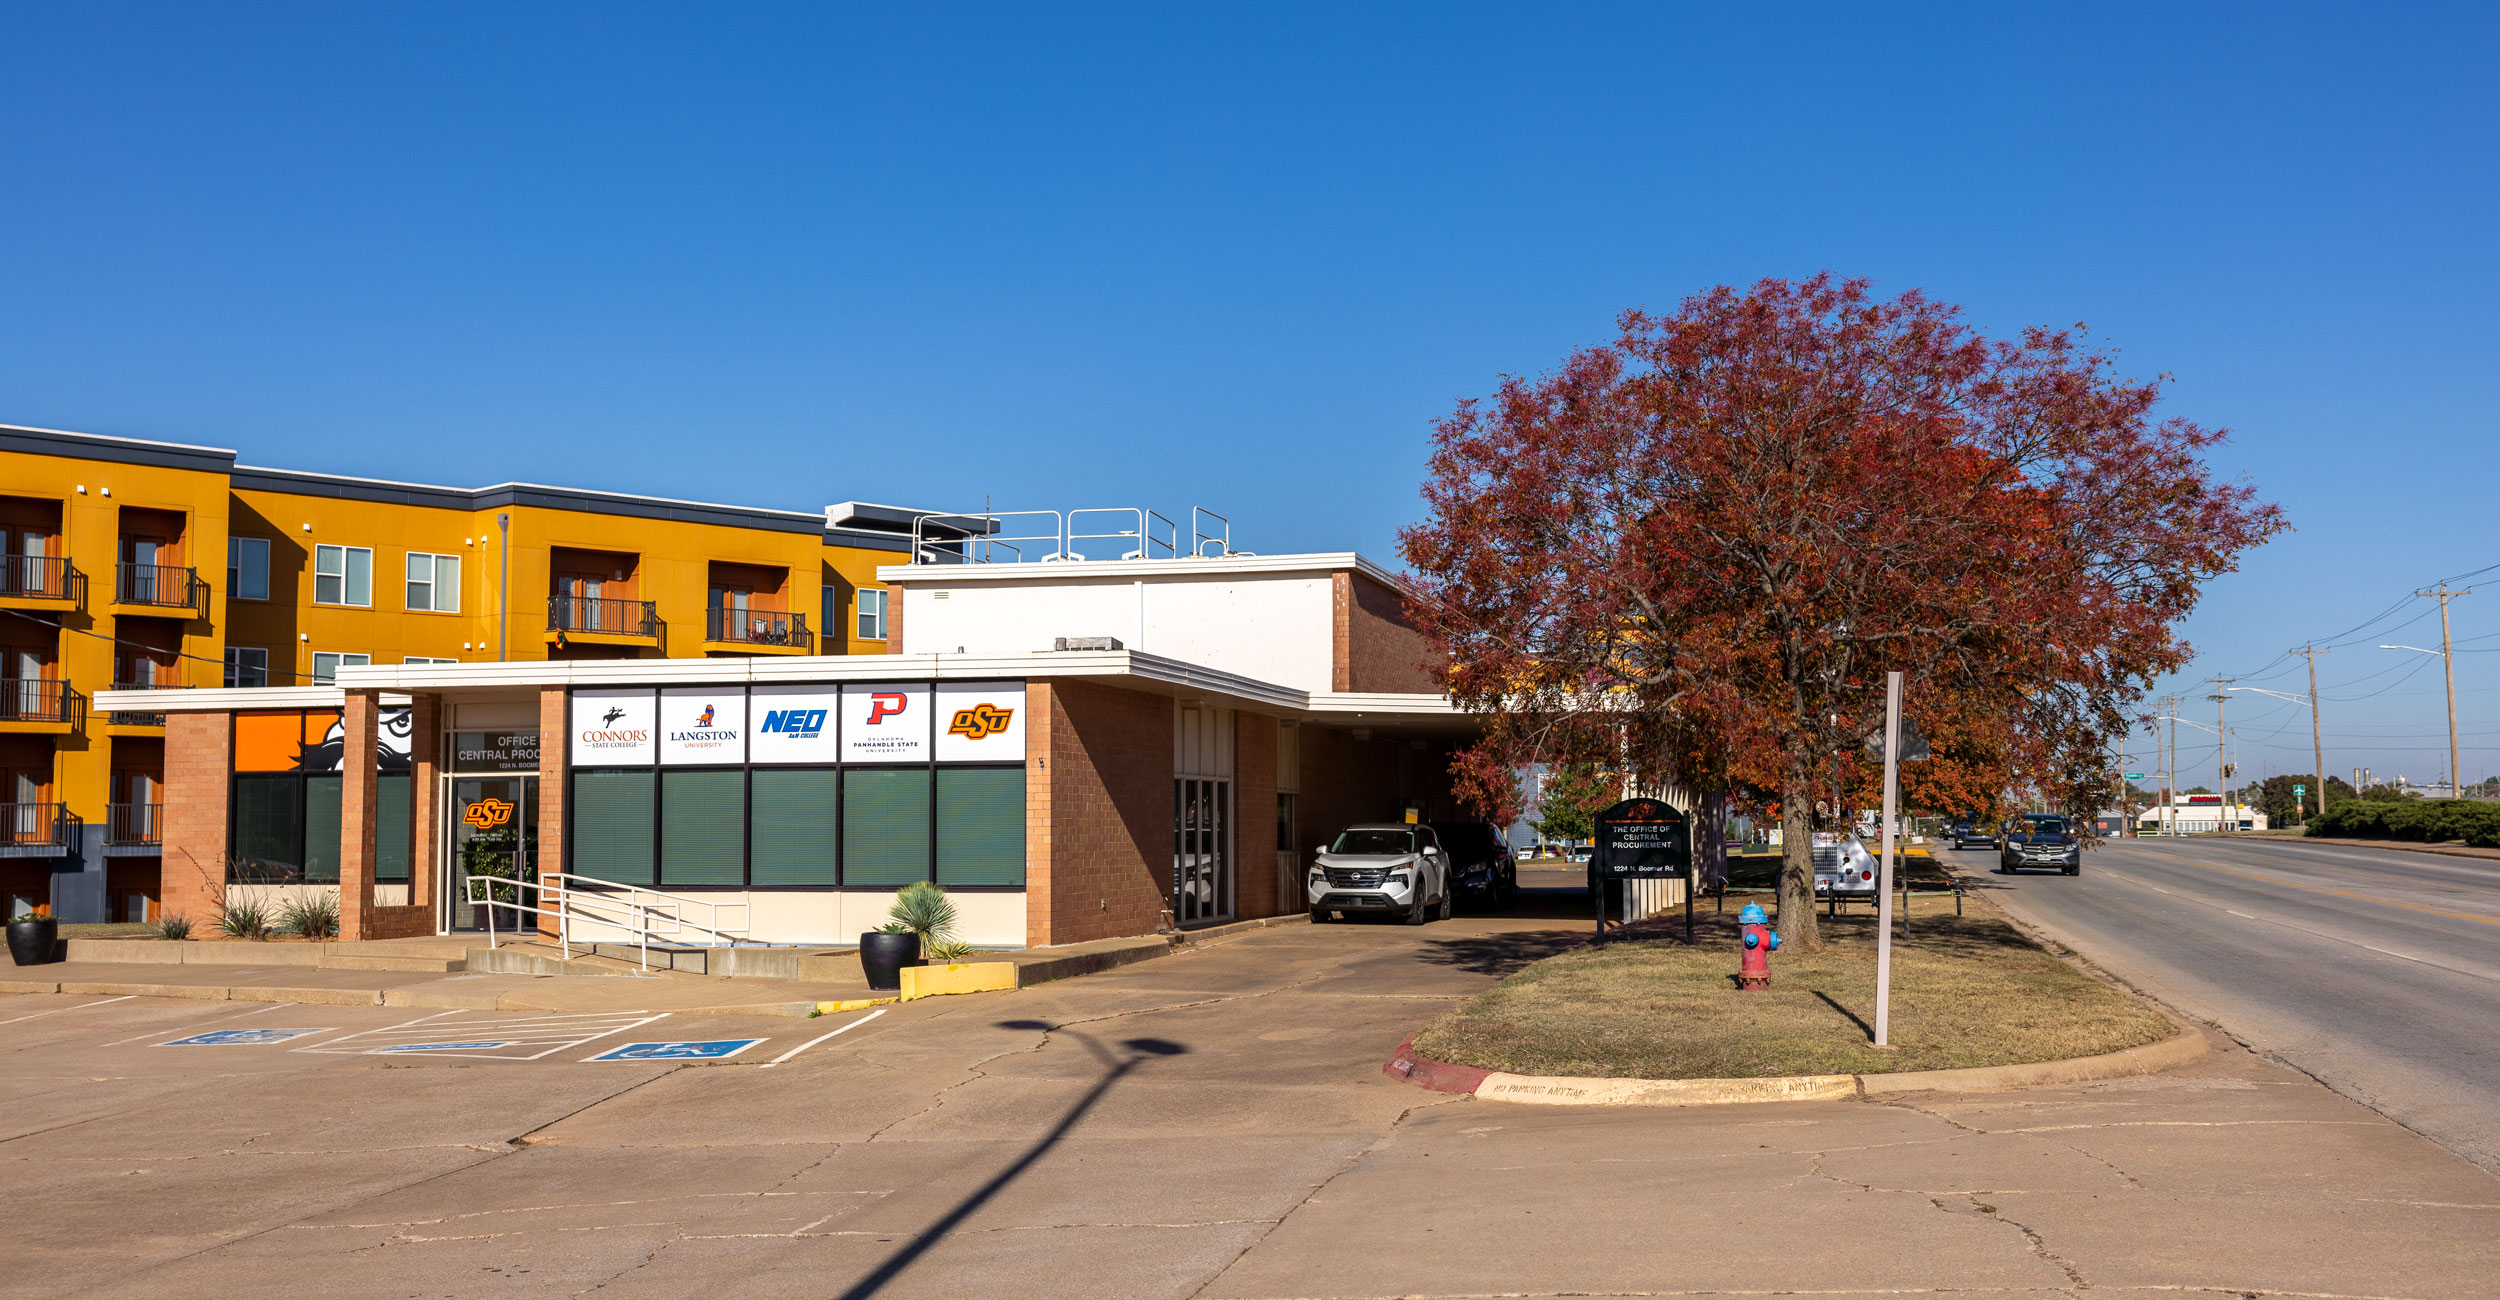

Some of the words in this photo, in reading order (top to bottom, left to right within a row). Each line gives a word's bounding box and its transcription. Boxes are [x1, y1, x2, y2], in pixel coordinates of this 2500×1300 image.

[761, 709, 828, 733] NEO
[947, 703, 1015, 740] OSU
[497, 735, 537, 746] OFFICE
[582, 729, 647, 743] CONNORS
[671, 730, 737, 741] LANGSTON
[458, 750, 509, 760] CENTRAL
[462, 798, 515, 829] OSU
[1612, 825, 1629, 833] THE
[1630, 825, 1658, 833] OFFICE
[1659, 825, 1671, 833] OF
[1612, 841, 1672, 849] PROCUREMENT
[1493, 1084, 1506, 1093] NO
[1508, 1084, 1546, 1094] PARKING
[1547, 1086, 1590, 1098] ANYTIME
